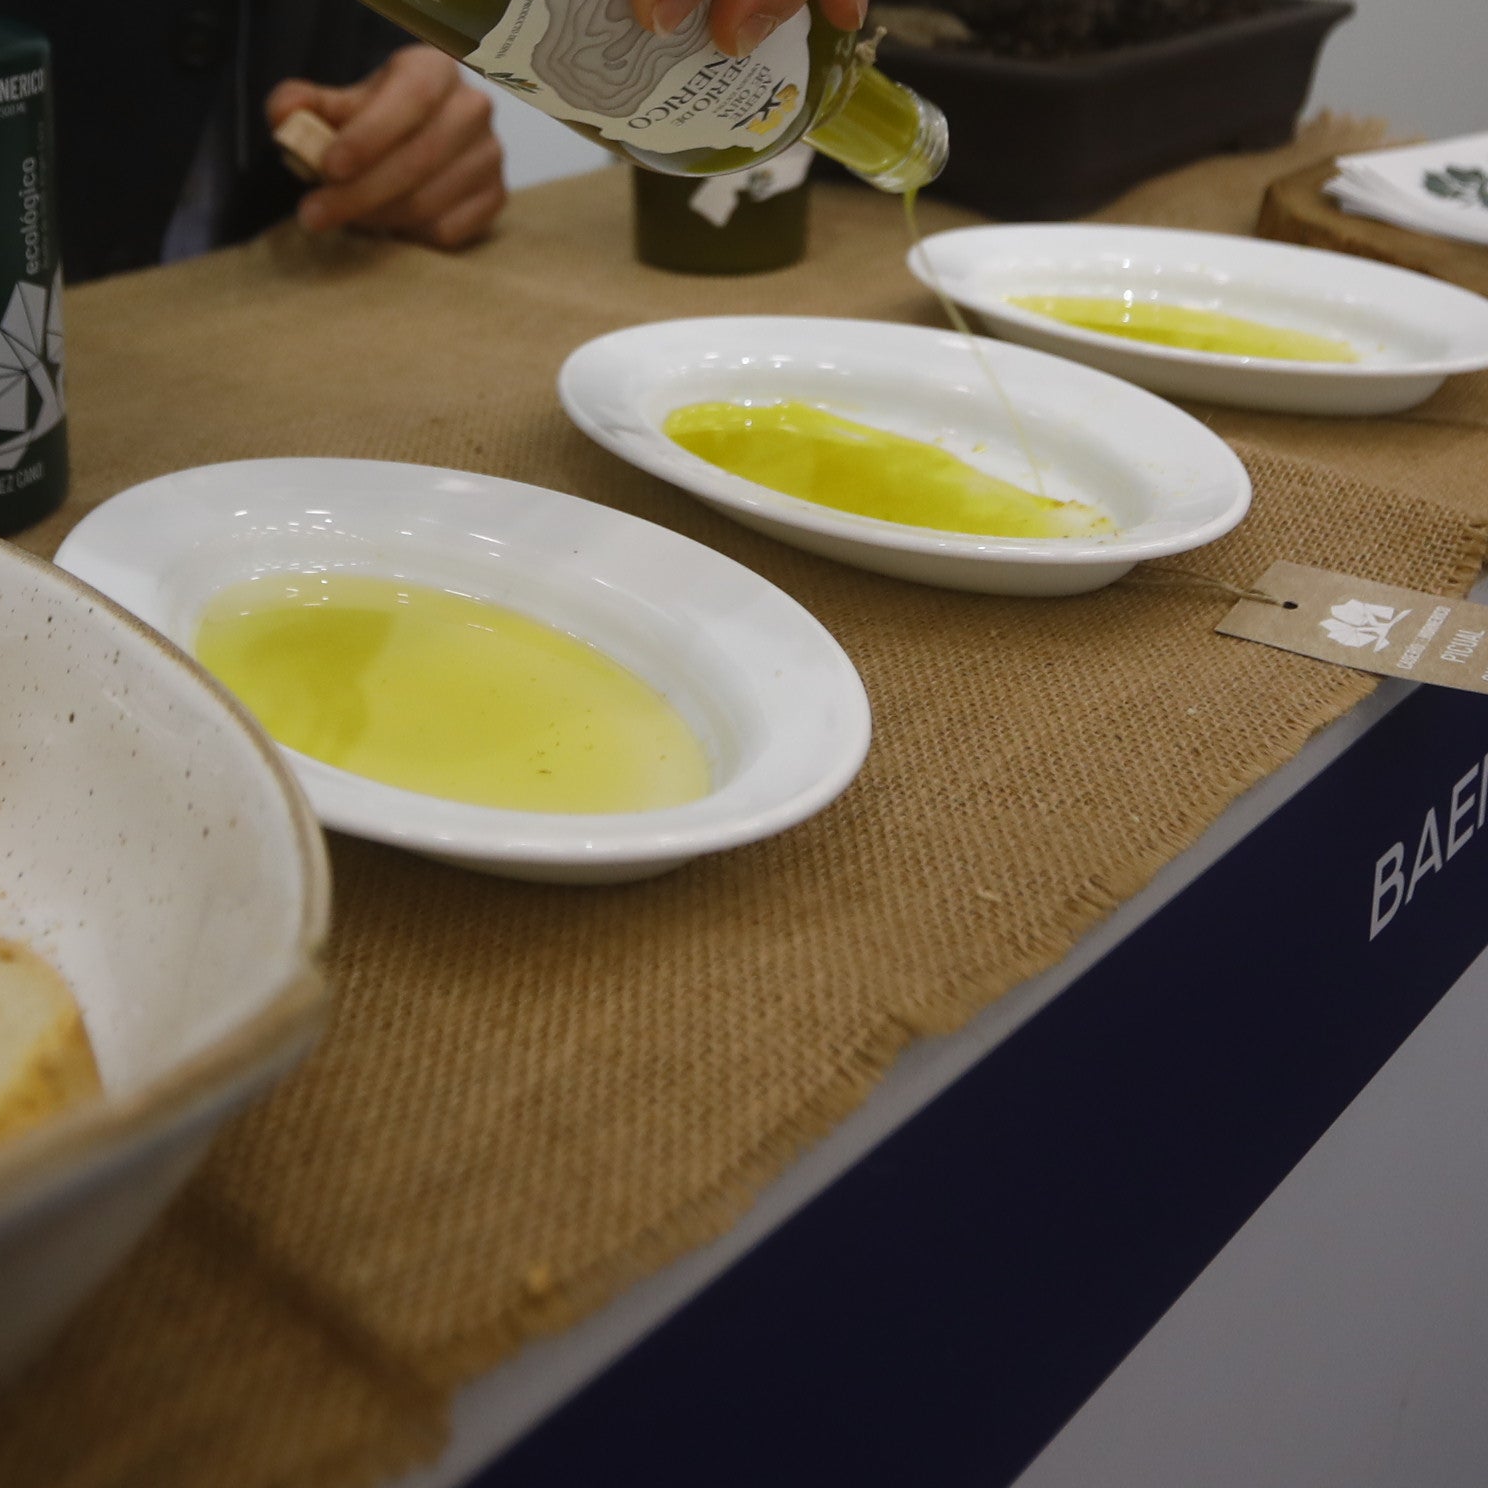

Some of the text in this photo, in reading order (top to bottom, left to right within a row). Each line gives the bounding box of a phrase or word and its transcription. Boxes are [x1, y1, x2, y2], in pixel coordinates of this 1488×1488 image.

[627, 51, 730, 129] NERICO
[671, 55, 751, 127] SERÍO DE
[19, 157, 40, 275] ecológico
[1440, 629, 1486, 664] PICUAL
